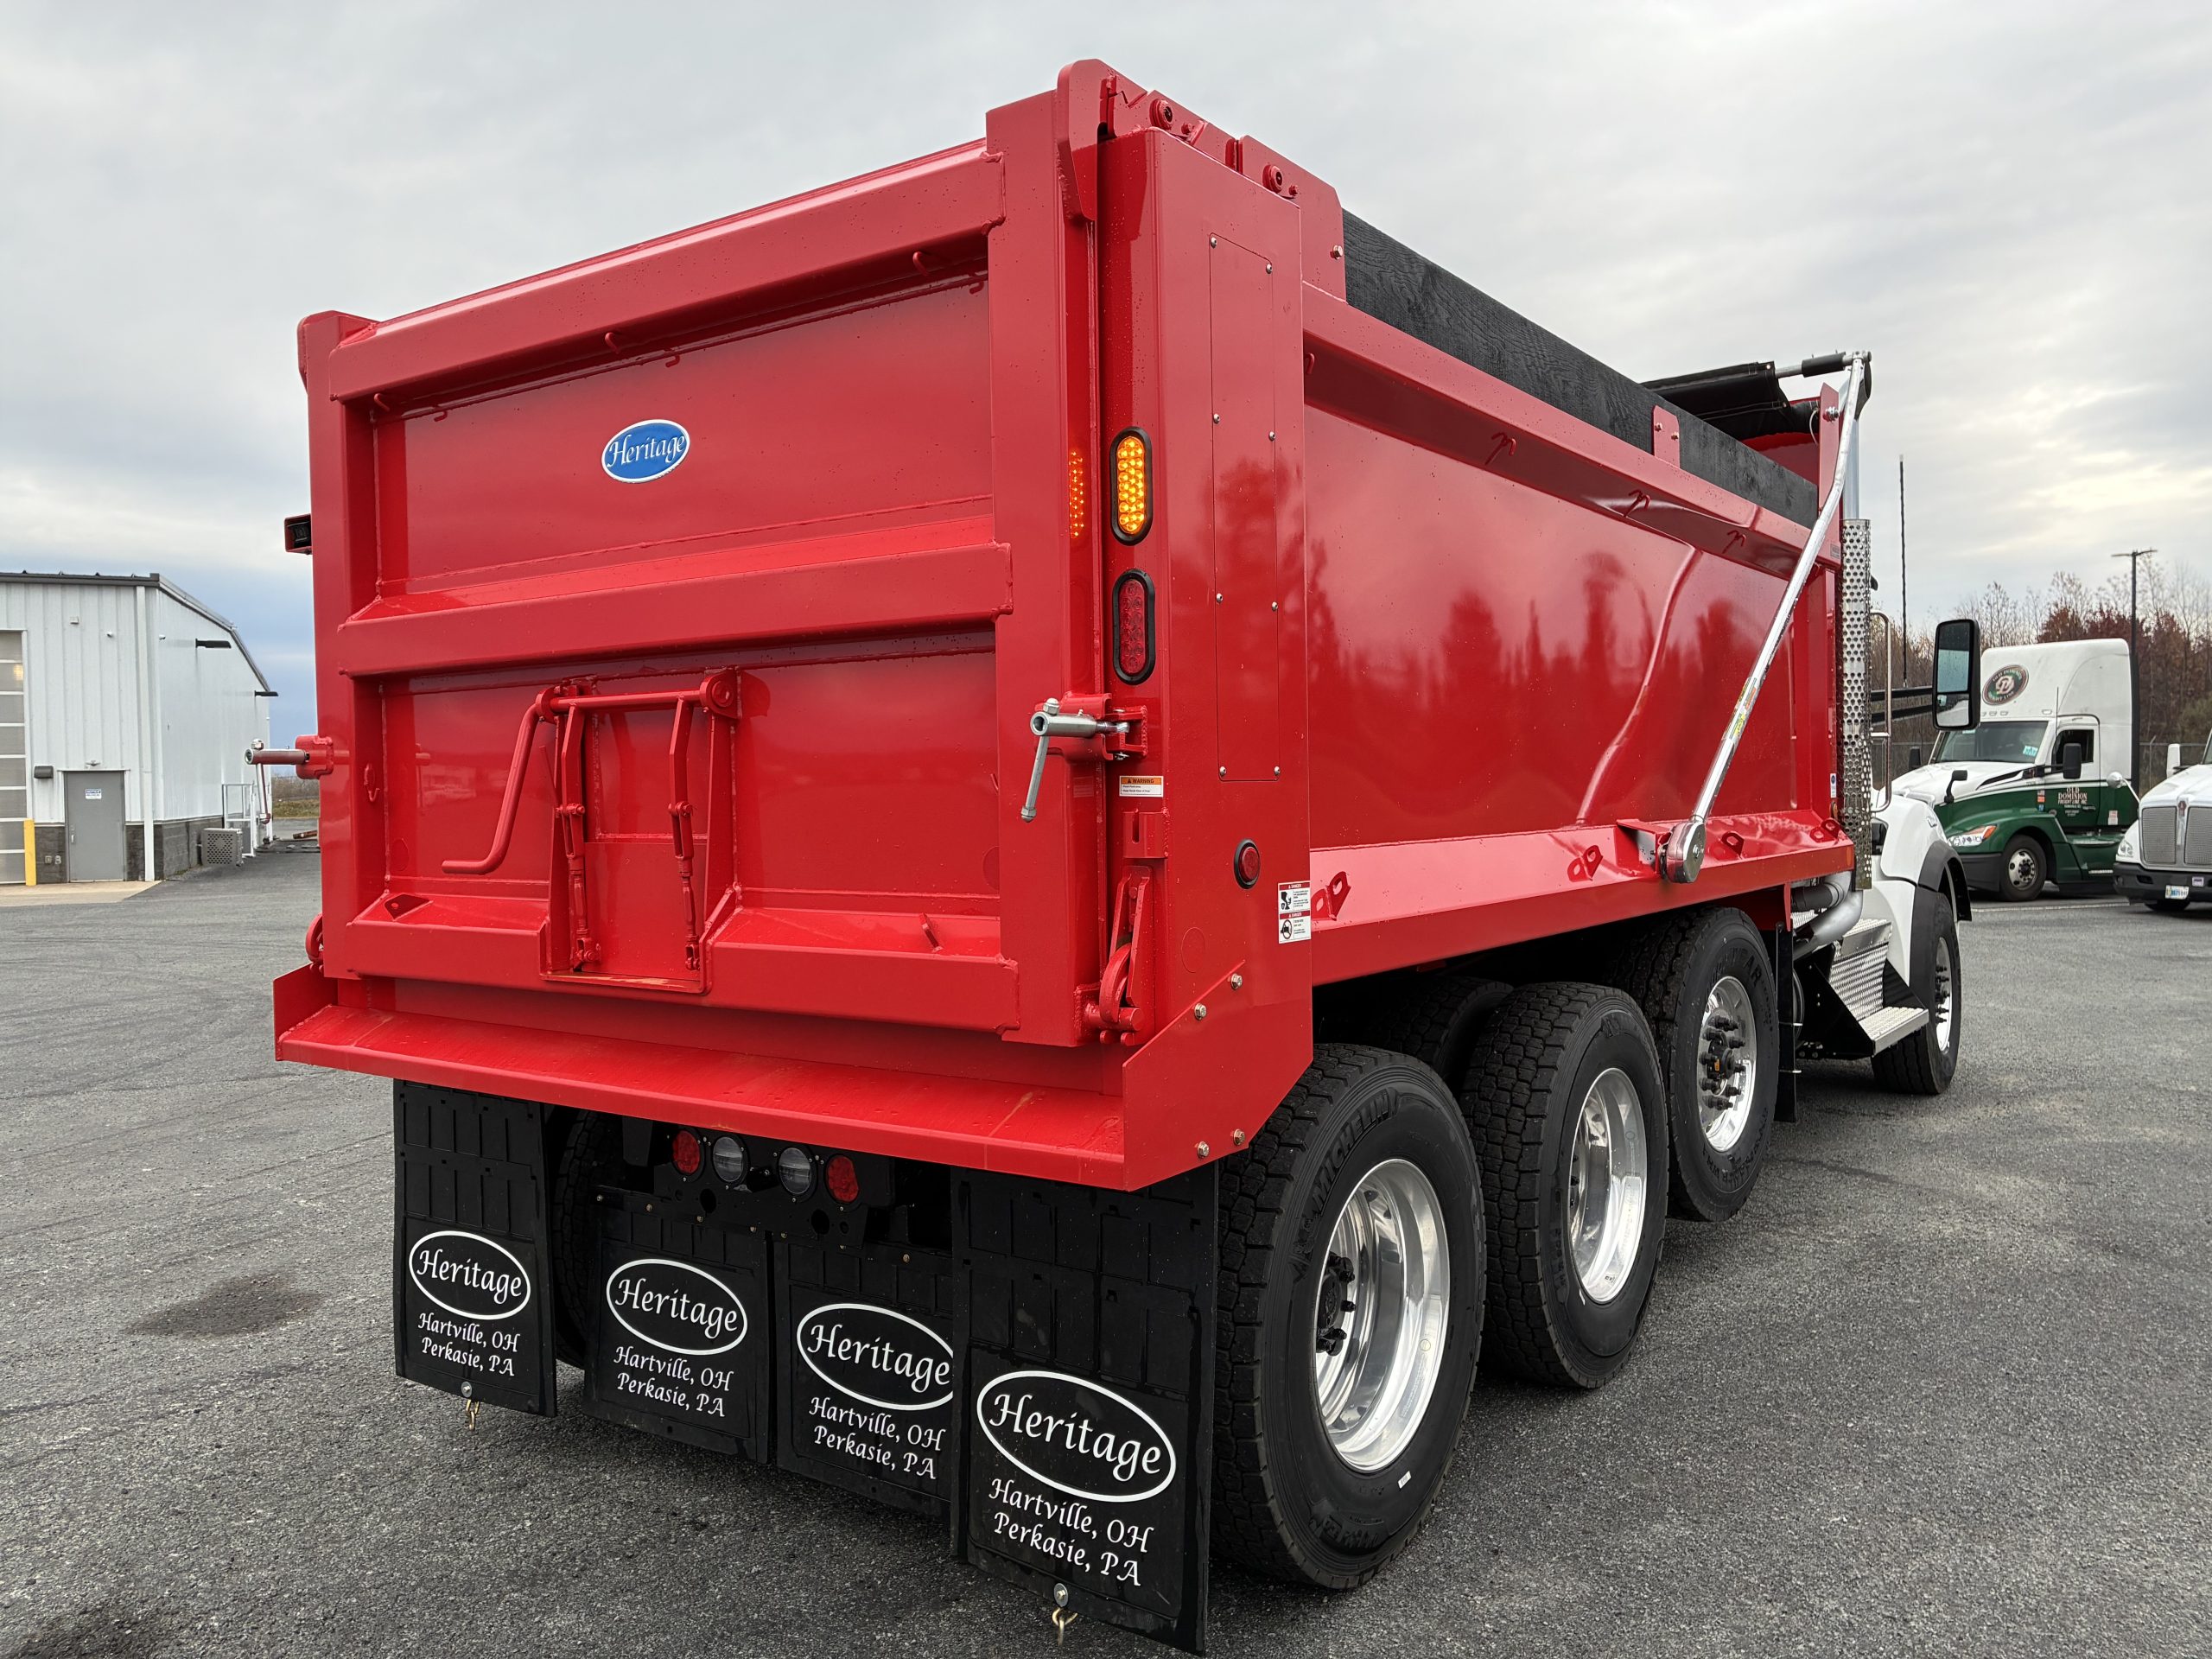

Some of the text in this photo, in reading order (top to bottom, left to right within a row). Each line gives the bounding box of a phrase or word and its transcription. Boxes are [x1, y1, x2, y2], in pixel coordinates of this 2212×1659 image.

[607, 434, 685, 467] Heritage
[1312, 1091, 1389, 1211] MICHELIN
[416, 1249, 522, 1305] Heritage
[417, 1313, 521, 1352] Hartville, OH
[615, 1279, 738, 1339] Heritage
[422, 1338, 515, 1376] Perkasie, PA
[613, 1346, 734, 1392] Hartville, OH
[807, 1325, 950, 1393] Heritage
[618, 1373, 725, 1417] Perkasie, PA
[810, 1397, 946, 1452] Hartville, OH
[989, 1395, 1161, 1482] Heritage
[814, 1426, 937, 1480] Perkasie, PA
[988, 1478, 1154, 1553] Hartville, OH
[995, 1512, 1141, 1586] Perkasie, PA
